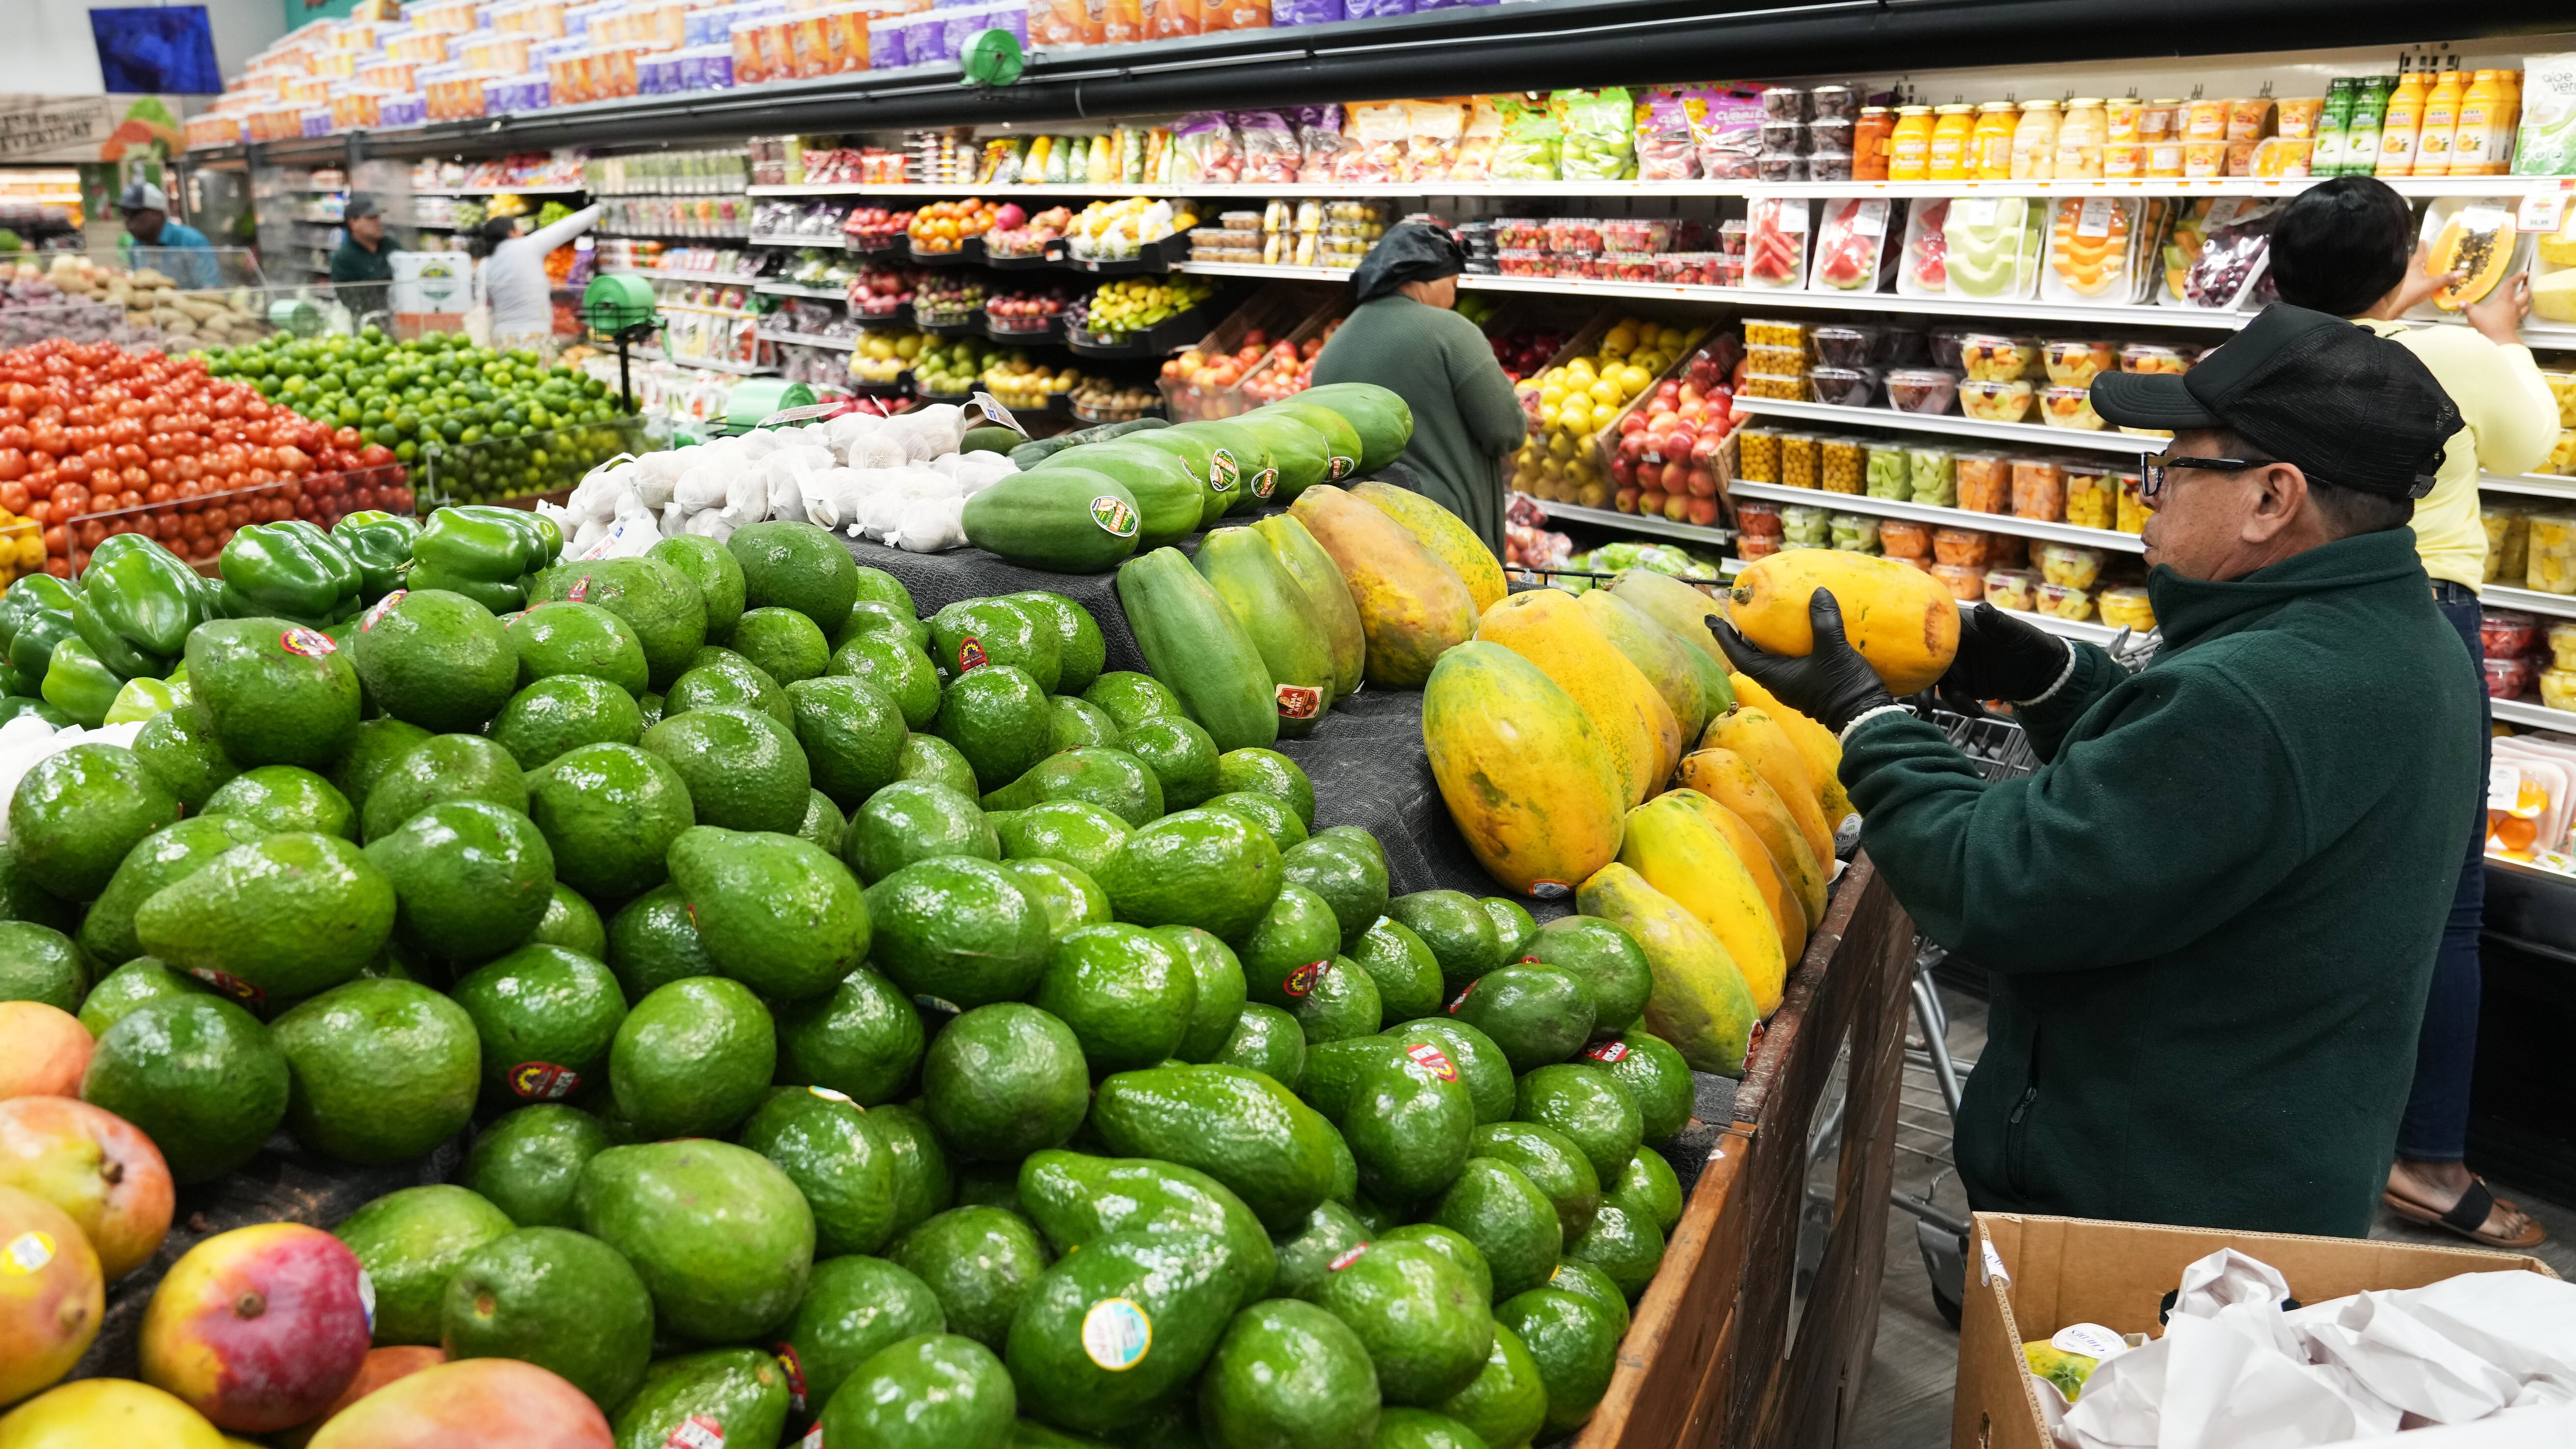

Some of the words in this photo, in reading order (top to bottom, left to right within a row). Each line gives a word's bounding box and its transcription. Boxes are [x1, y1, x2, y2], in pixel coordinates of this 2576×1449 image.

[2543, 71, 2572, 82] aloe
[2552, 81, 2576, 92] ver
[1216, 457, 1236, 474] Fruit
[1219, 452, 1235, 466] Pana
[1221, 468, 1234, 479] COOKING
[1260, 472, 1273, 495] Fruit
[1104, 508, 1114, 527] COOKING
[1111, 504, 1126, 530] Fruit
[1120, 511, 1132, 530] Pana
[1286, 693, 1298, 714] MAMA
[1294, 697, 1303, 712] ANA
